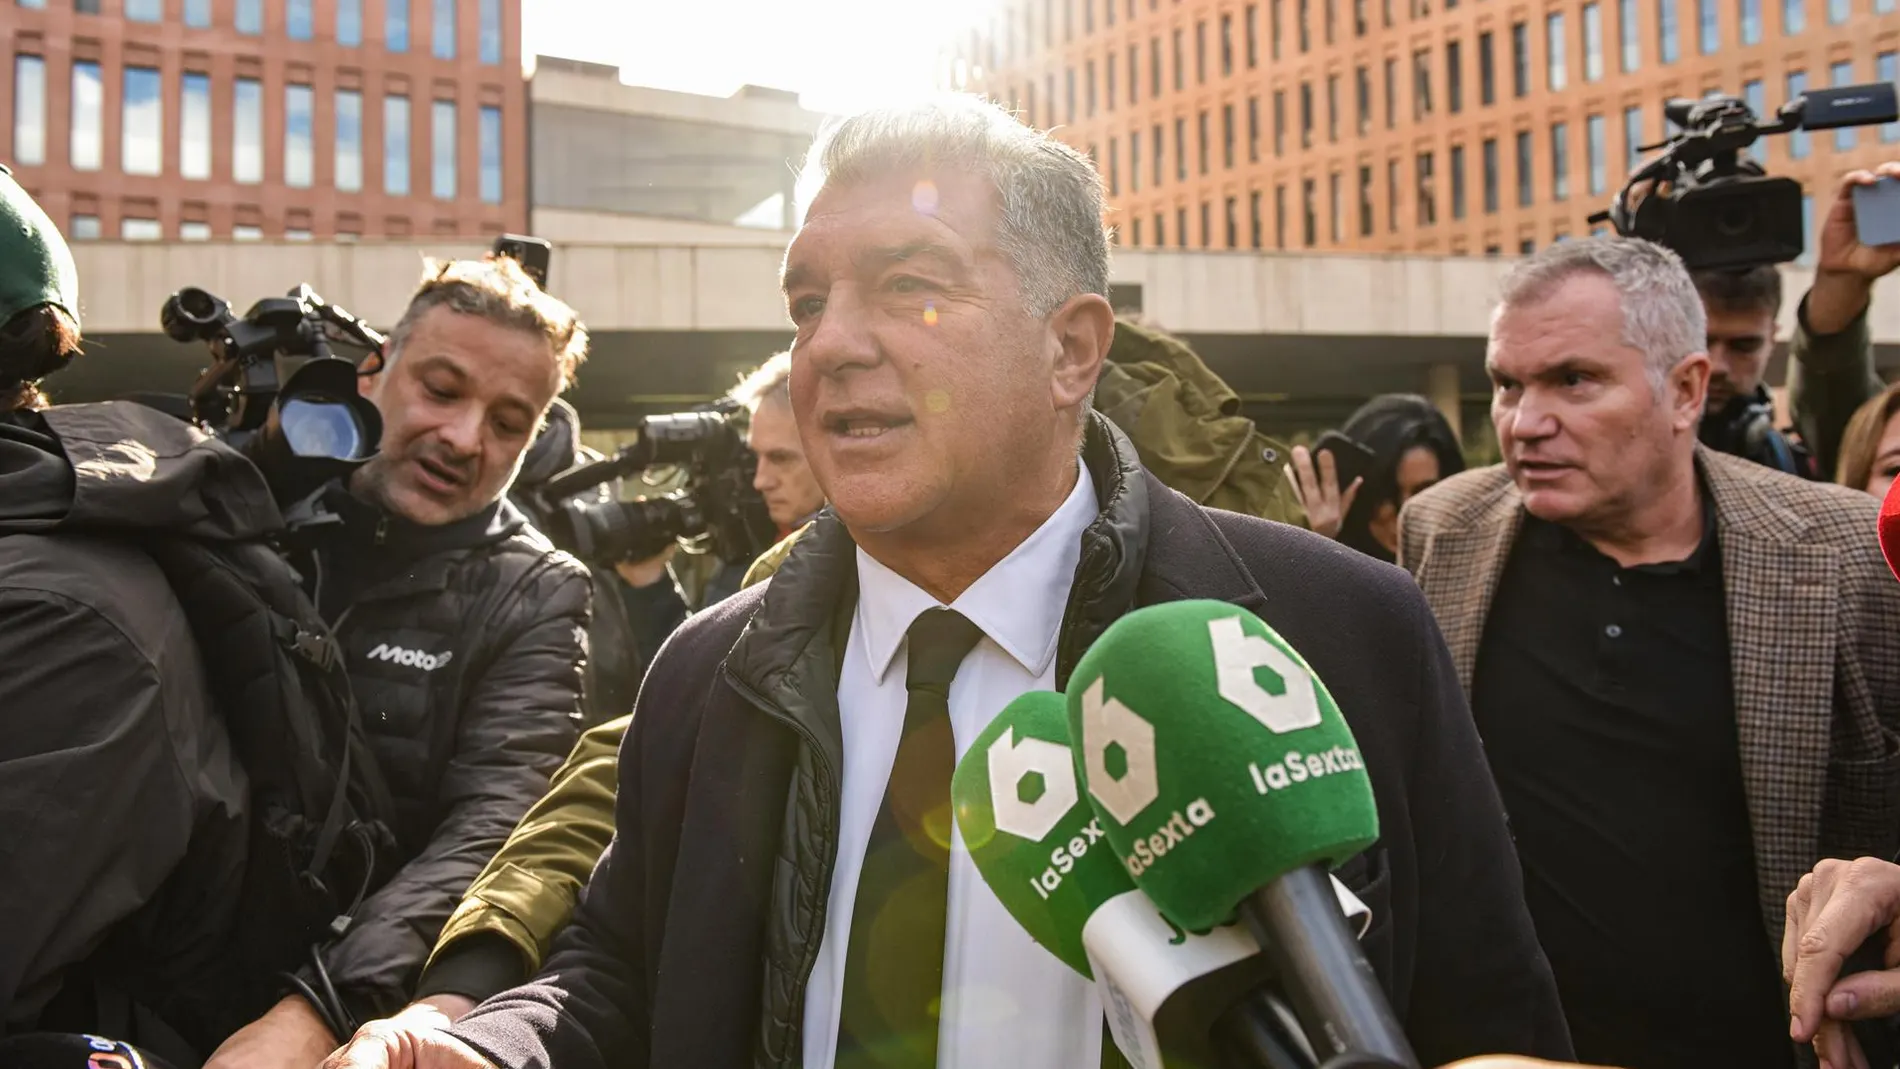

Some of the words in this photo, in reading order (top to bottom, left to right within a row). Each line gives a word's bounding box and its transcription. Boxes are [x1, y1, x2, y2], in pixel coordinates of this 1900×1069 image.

[1249, 745, 1363, 795] laSexta
[1029, 816, 1105, 900] laSex
[1120, 797, 1216, 877] aSexta
